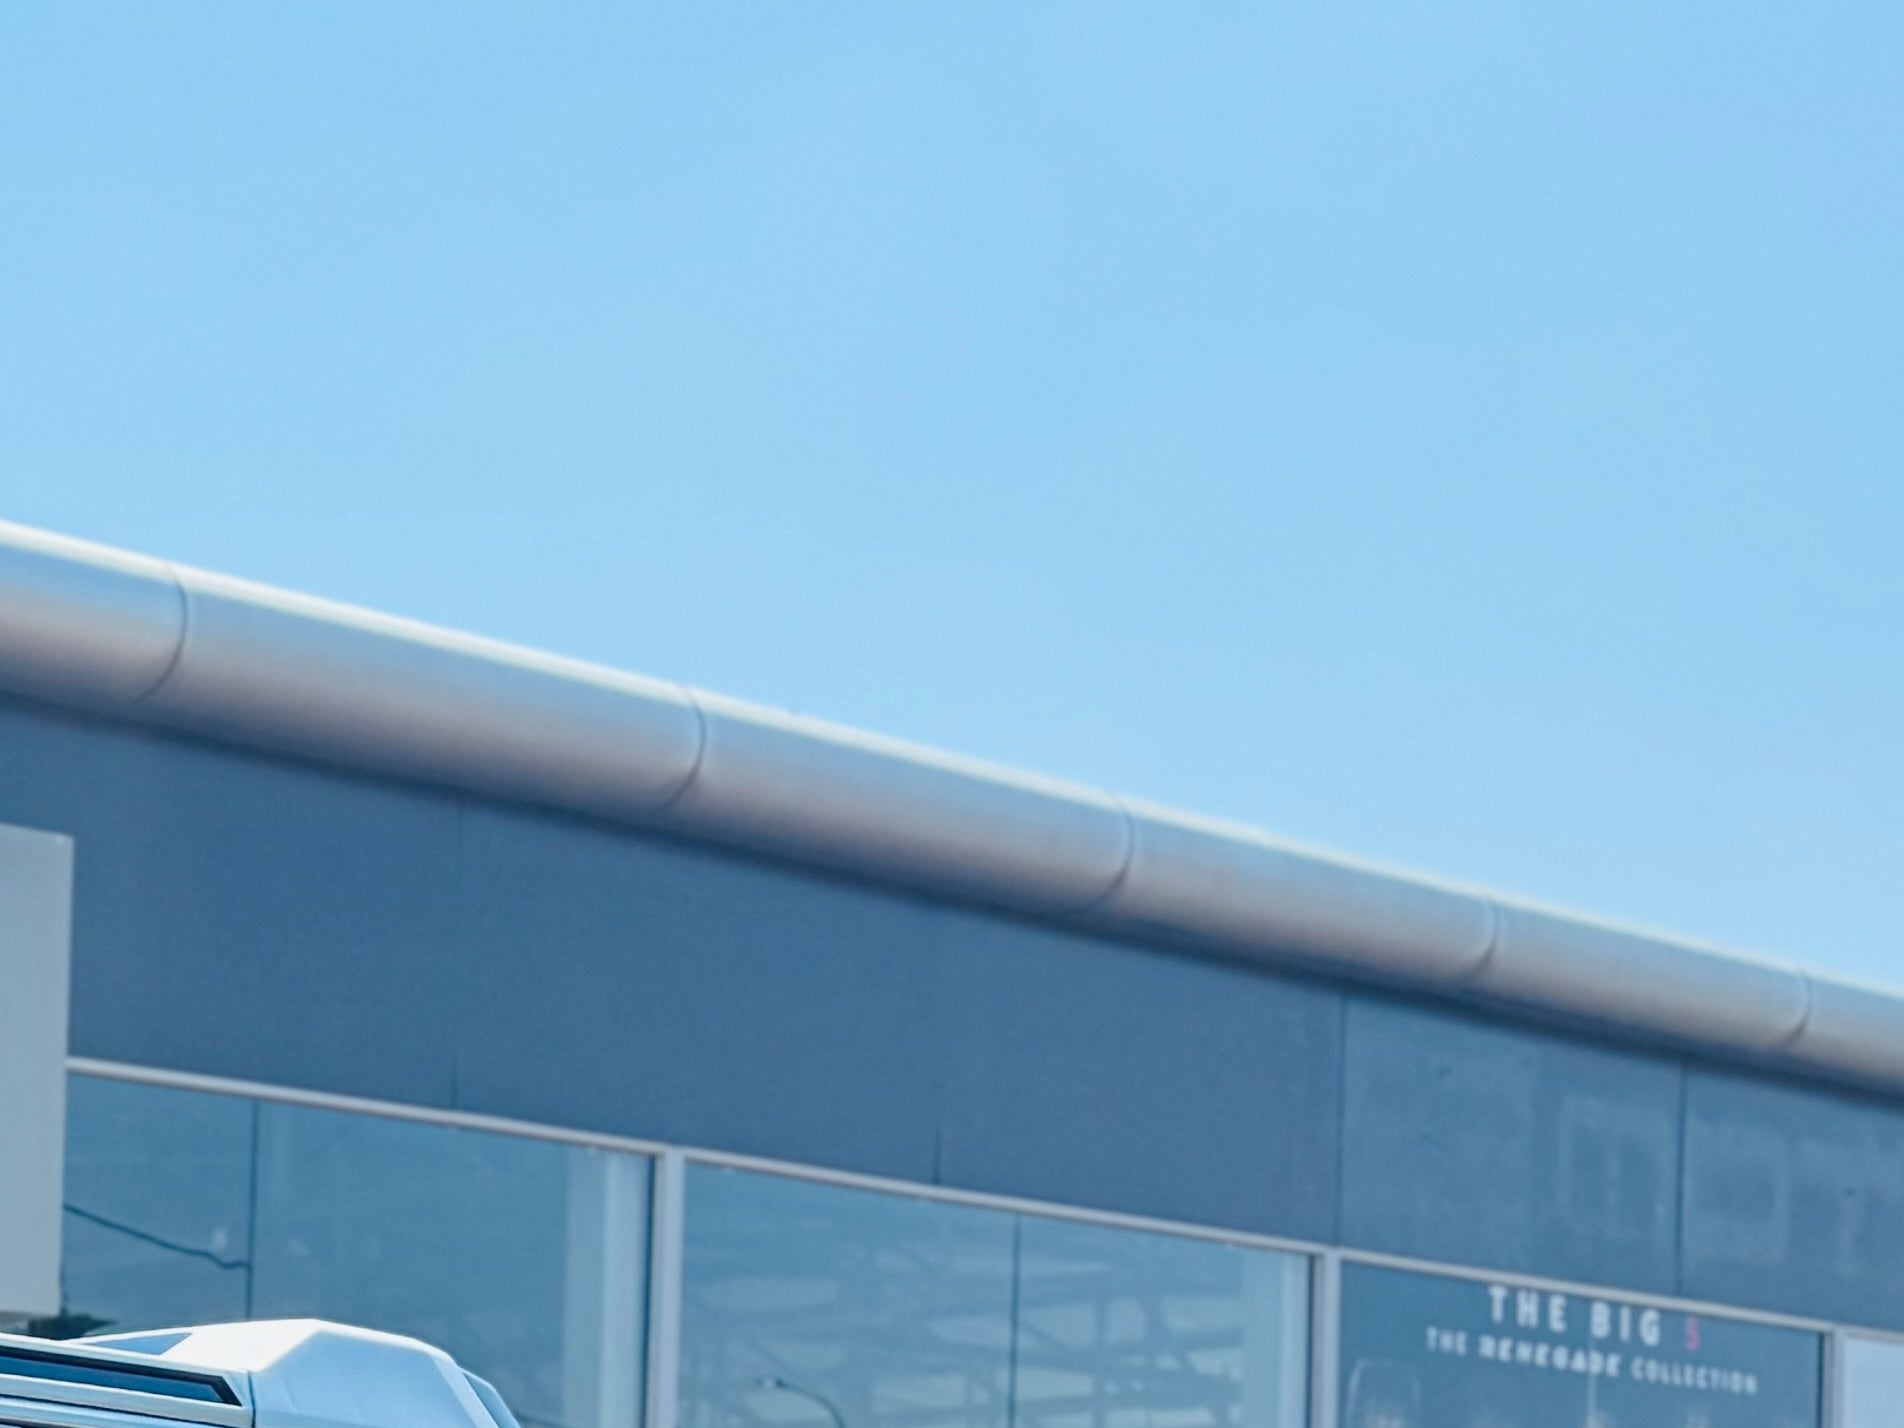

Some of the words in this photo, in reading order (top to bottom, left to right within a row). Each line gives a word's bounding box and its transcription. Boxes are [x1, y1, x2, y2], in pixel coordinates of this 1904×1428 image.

[1489, 1286, 1568, 1333] THE
[1591, 1300, 1661, 1347] BIG
[1478, 1334, 1621, 1378] RENEGADE
[1631, 1355, 1758, 1396] COLLECTION
